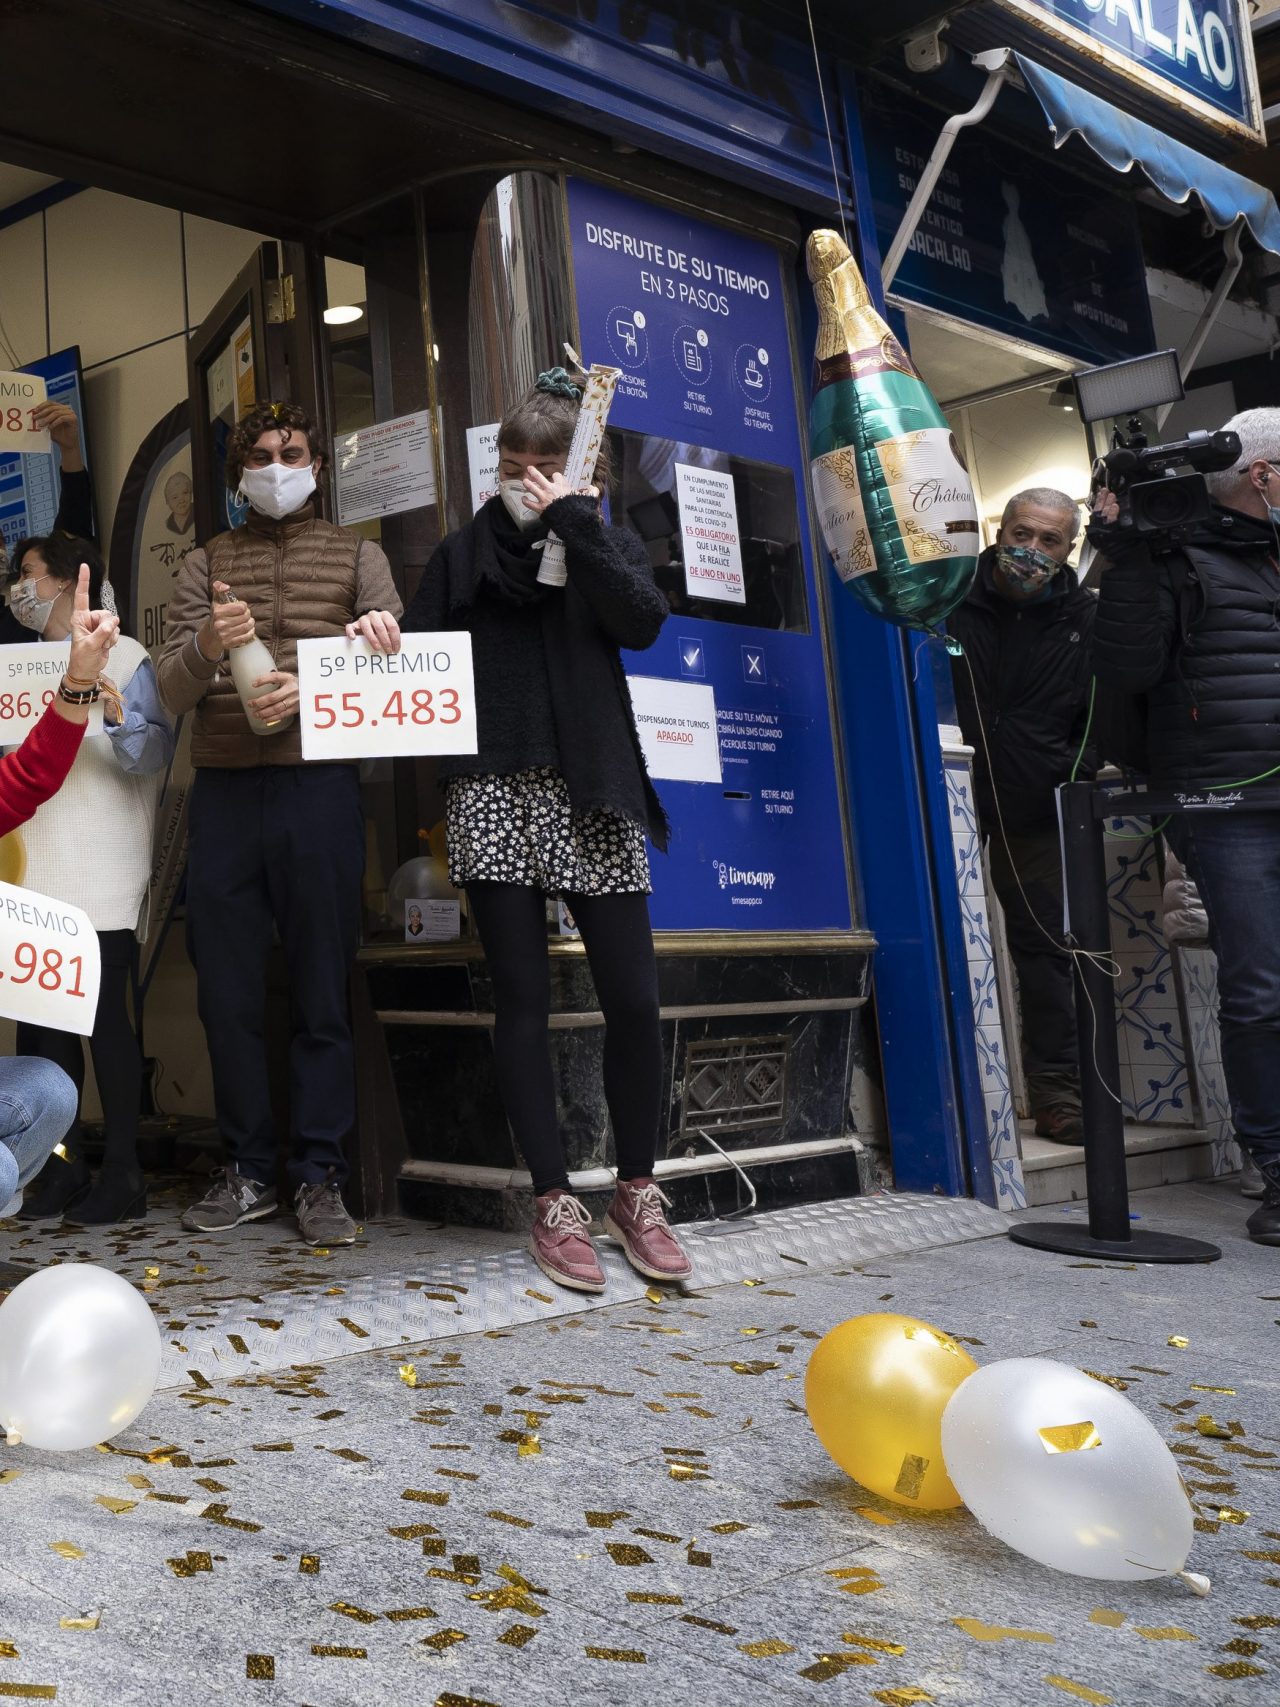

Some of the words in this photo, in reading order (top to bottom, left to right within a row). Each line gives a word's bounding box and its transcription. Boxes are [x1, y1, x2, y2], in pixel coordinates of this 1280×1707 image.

[586, 222, 664, 266] DISFRUTE
[667, 249, 688, 273] DE
[691, 257, 712, 281] SU
[714, 265, 770, 300] TIEMPO
[641, 271, 662, 296] EN
[665, 279, 675, 299] 3
[679, 283, 730, 316] PASOS
[618, 385, 626, 394] EL
[626, 386, 648, 399] BOTÓN
[687, 390, 707, 403] RETIRE
[683, 401, 692, 410] SU
[692, 402, 713, 416] TURNO
[743, 417, 752, 427] SU
[479, 436, 490, 444] EN
[683, 474, 691, 482] EN
[479, 491, 491, 501] ES
[696, 487, 705, 495] LAS
[705, 489, 726, 499] MEDIDAS
[685, 504, 698, 512] PARA
[695, 497, 722, 507] SANITARIAS
[694, 516, 704, 524] DEL
[704, 517, 727, 528] COVID-19
[685, 526, 693, 534] ES
[695, 527, 737, 543] OBLIGATORIO
[696, 541, 708, 551] QUE
[710, 543, 718, 551] LA
[719, 544, 731, 554] FILA
[699, 554, 706, 563] SE
[707, 556, 730, 567] REALICE
[689, 566, 699, 576] DE
[700, 568, 716, 578] UNO
[716, 570, 726, 579] EN
[726, 572, 741, 582] UNO
[8, 663, 23, 678] 5º
[320, 656, 345, 677] 5º
[355, 652, 451, 676] PREMIO
[313, 688, 462, 729] 55.483
[637, 714, 677, 726] DISPENSADOR
[677, 719, 685, 727] DE
[686, 720, 710, 730] TURNOS
[734, 712, 743, 721] SU
[755, 712, 774, 724] MÓVIL
[774, 716, 778, 724] Y
[656, 730, 694, 743] APAGADO
[736, 726, 745, 735] UN
[746, 727, 758, 736] SMS
[758, 728, 782, 739] CUANDO
[720, 739, 747, 750] ACERQUE
[747, 741, 756, 751] SU
[756, 742, 776, 752] TURNO
[761, 789, 780, 800] RETIRE
[780, 789, 795, 801] AQUÍ
[765, 804, 773, 813] SU
[773, 804, 793, 814] TURNO
[728, 866, 776, 890] timesapp
